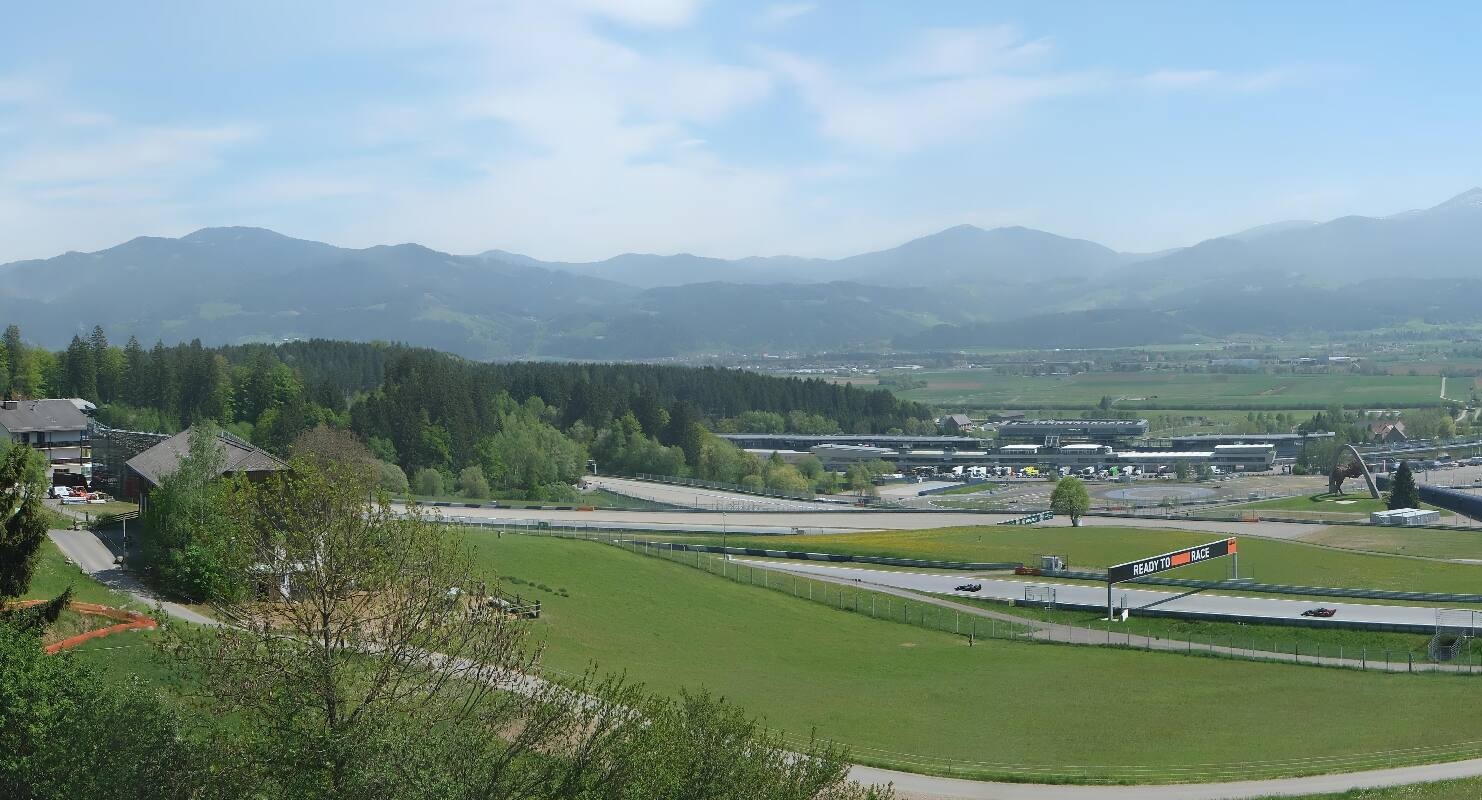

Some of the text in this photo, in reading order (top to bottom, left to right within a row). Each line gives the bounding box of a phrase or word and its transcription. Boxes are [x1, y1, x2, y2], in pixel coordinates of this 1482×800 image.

[1133, 547, 1210, 576] READY TO RACE
